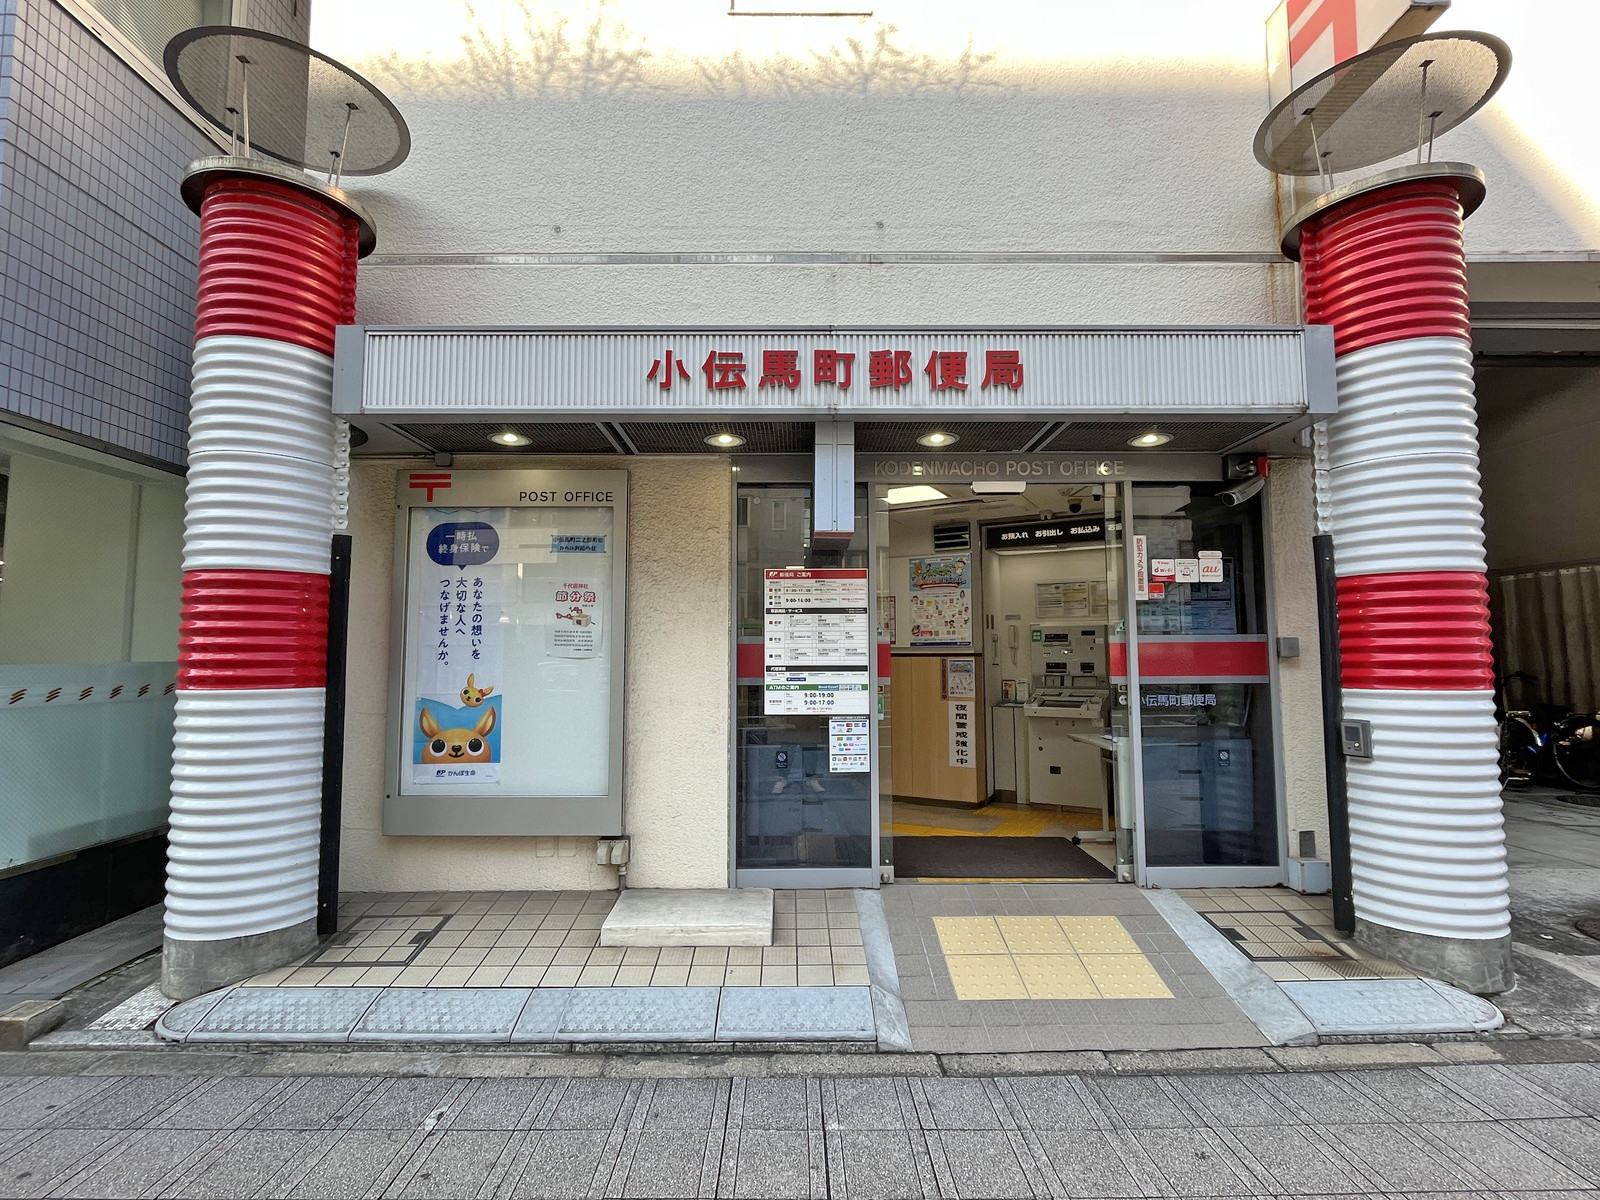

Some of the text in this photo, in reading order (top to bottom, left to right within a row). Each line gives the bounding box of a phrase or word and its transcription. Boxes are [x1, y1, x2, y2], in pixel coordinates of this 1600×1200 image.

[647, 349, 1023, 390] 小伝馬町郵便局
[874, 460, 1125, 476] KODENMACHO POST OFFICE
[519, 491, 613, 502] POST OFFICE
[445, 531, 478, 541] 一時払
[1001, 531, 1029, 540] お預入れ
[1035, 528, 1063, 537] お引出し
[1070, 525, 1100, 535] お払込み
[438, 544, 489, 554] 終身保険で
[1202, 565, 1221, 573] au
[555, 590, 596, 602] 節分祭
[455, 577, 467, 635] 大切な人へ
[438, 578, 451, 666] つなげませんか。
[471, 577, 483, 660] あなたの想いを
[955, 704, 968, 765] 夜間警戒強化中
[448, 769, 476, 777] かんぽ生命
